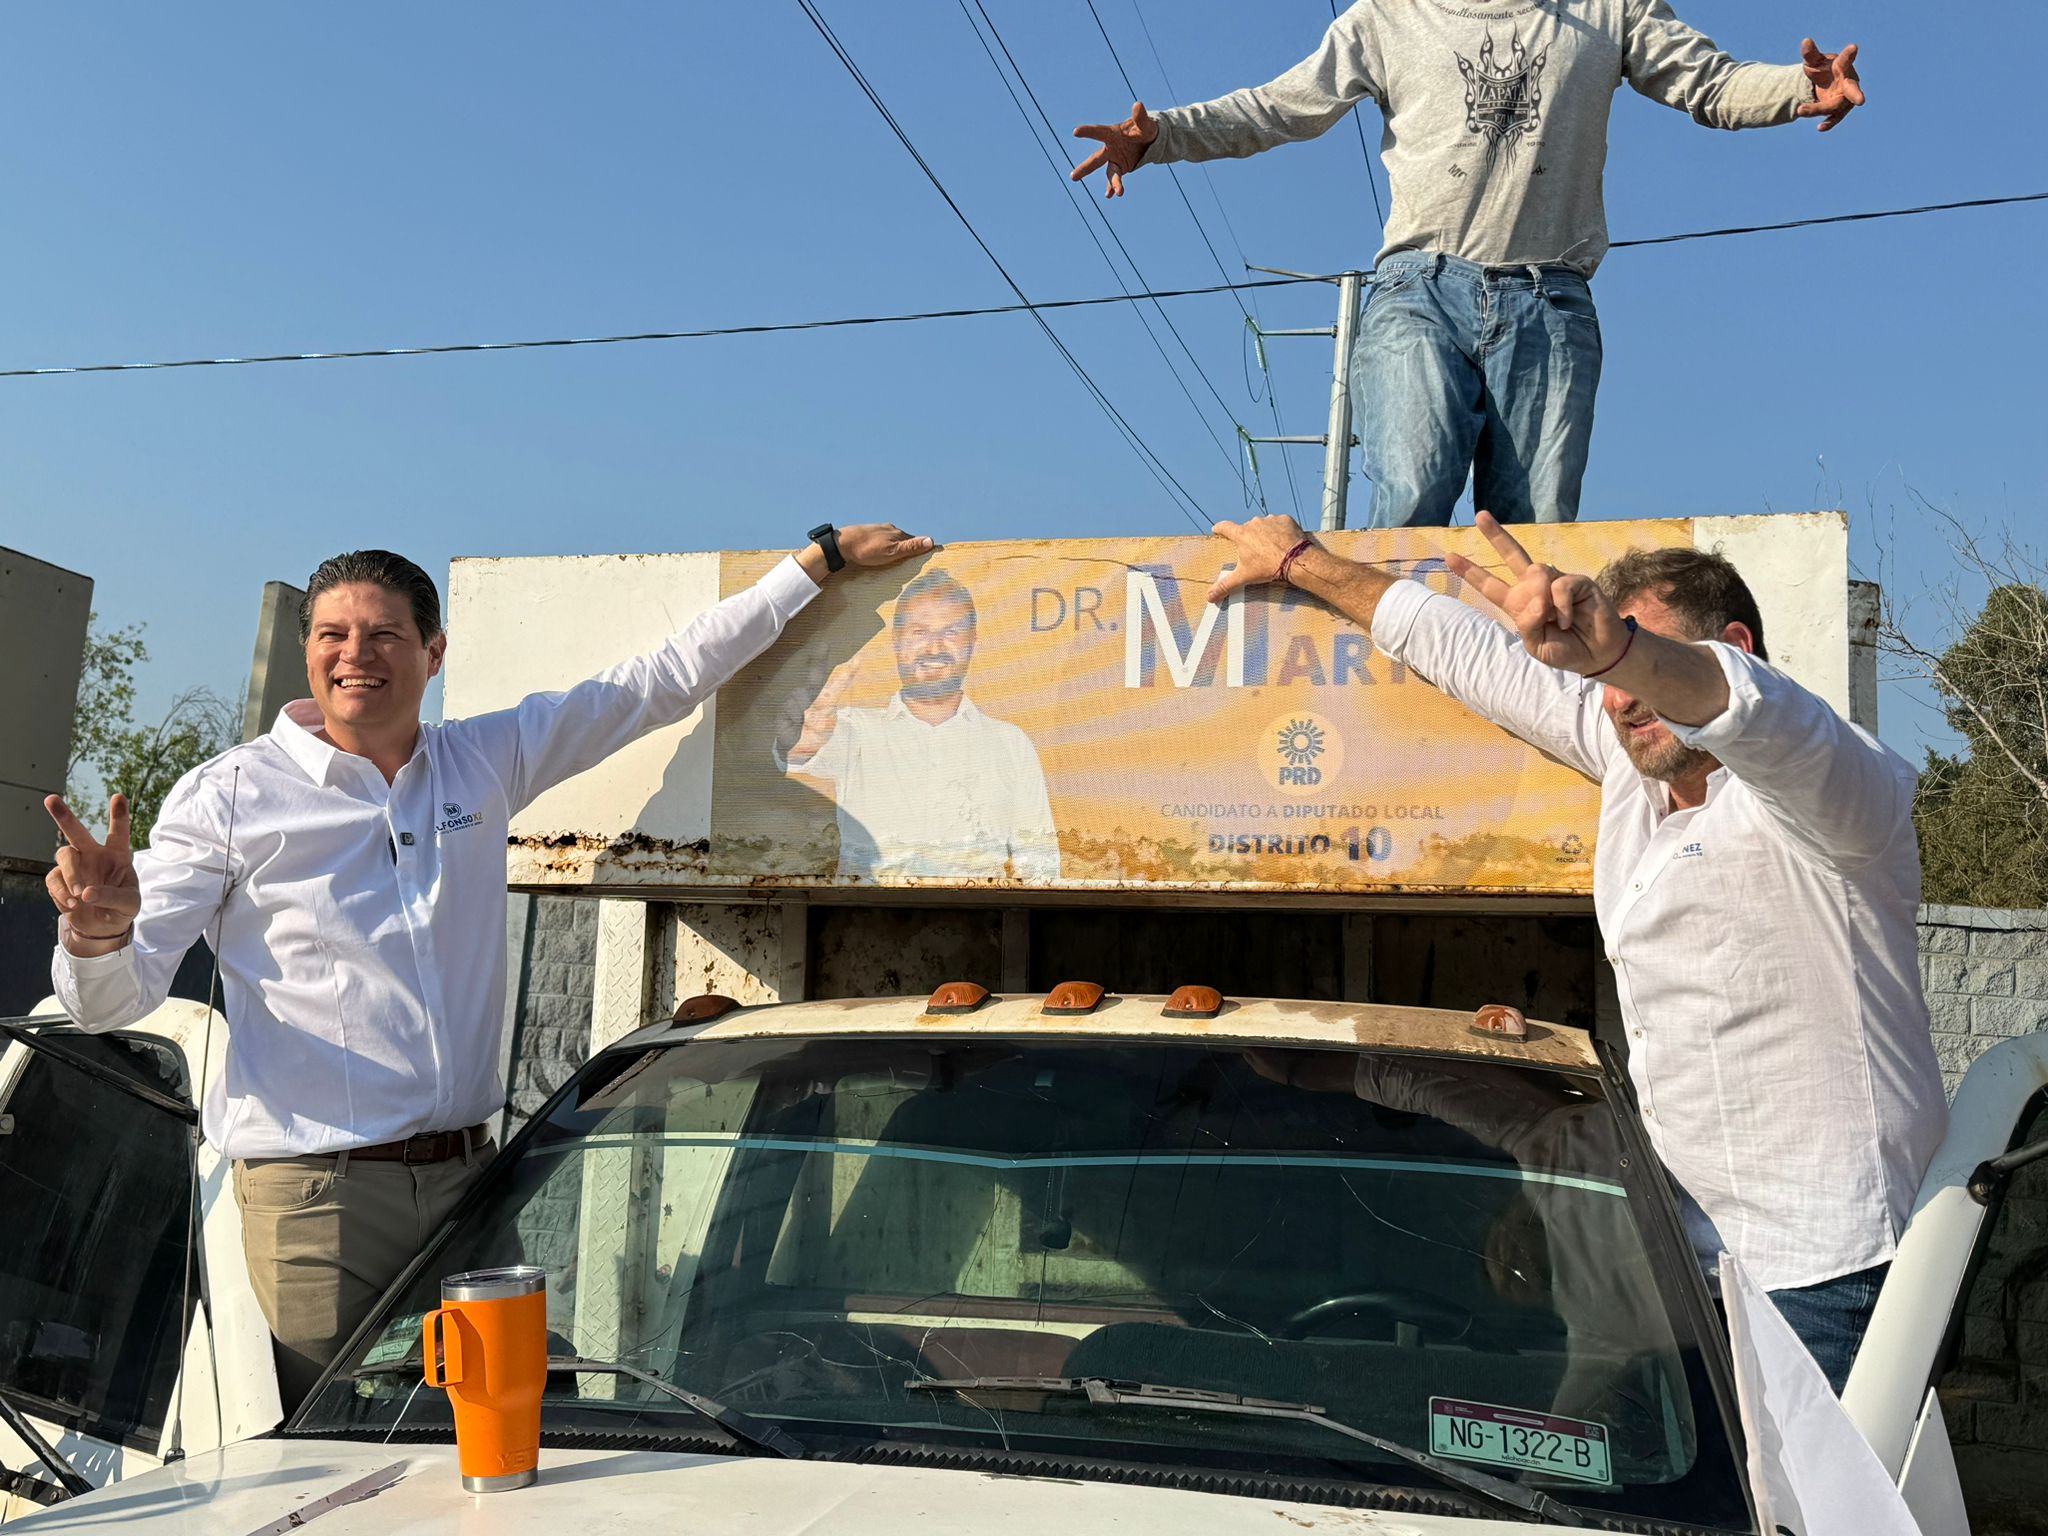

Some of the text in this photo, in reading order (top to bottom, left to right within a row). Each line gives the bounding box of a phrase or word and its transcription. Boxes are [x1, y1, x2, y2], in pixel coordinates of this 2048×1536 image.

[1480, 80, 1527, 102] ZAPATA
[1030, 587, 1118, 632] DR.
[1278, 766, 1322, 785] PRD
[1160, 803, 1444, 820] CANDIDATO A DIPUTADO LOCAL
[1208, 826, 1393, 861] DISTRITO 10
[1450, 1417, 1592, 1468] NG-1322-B
